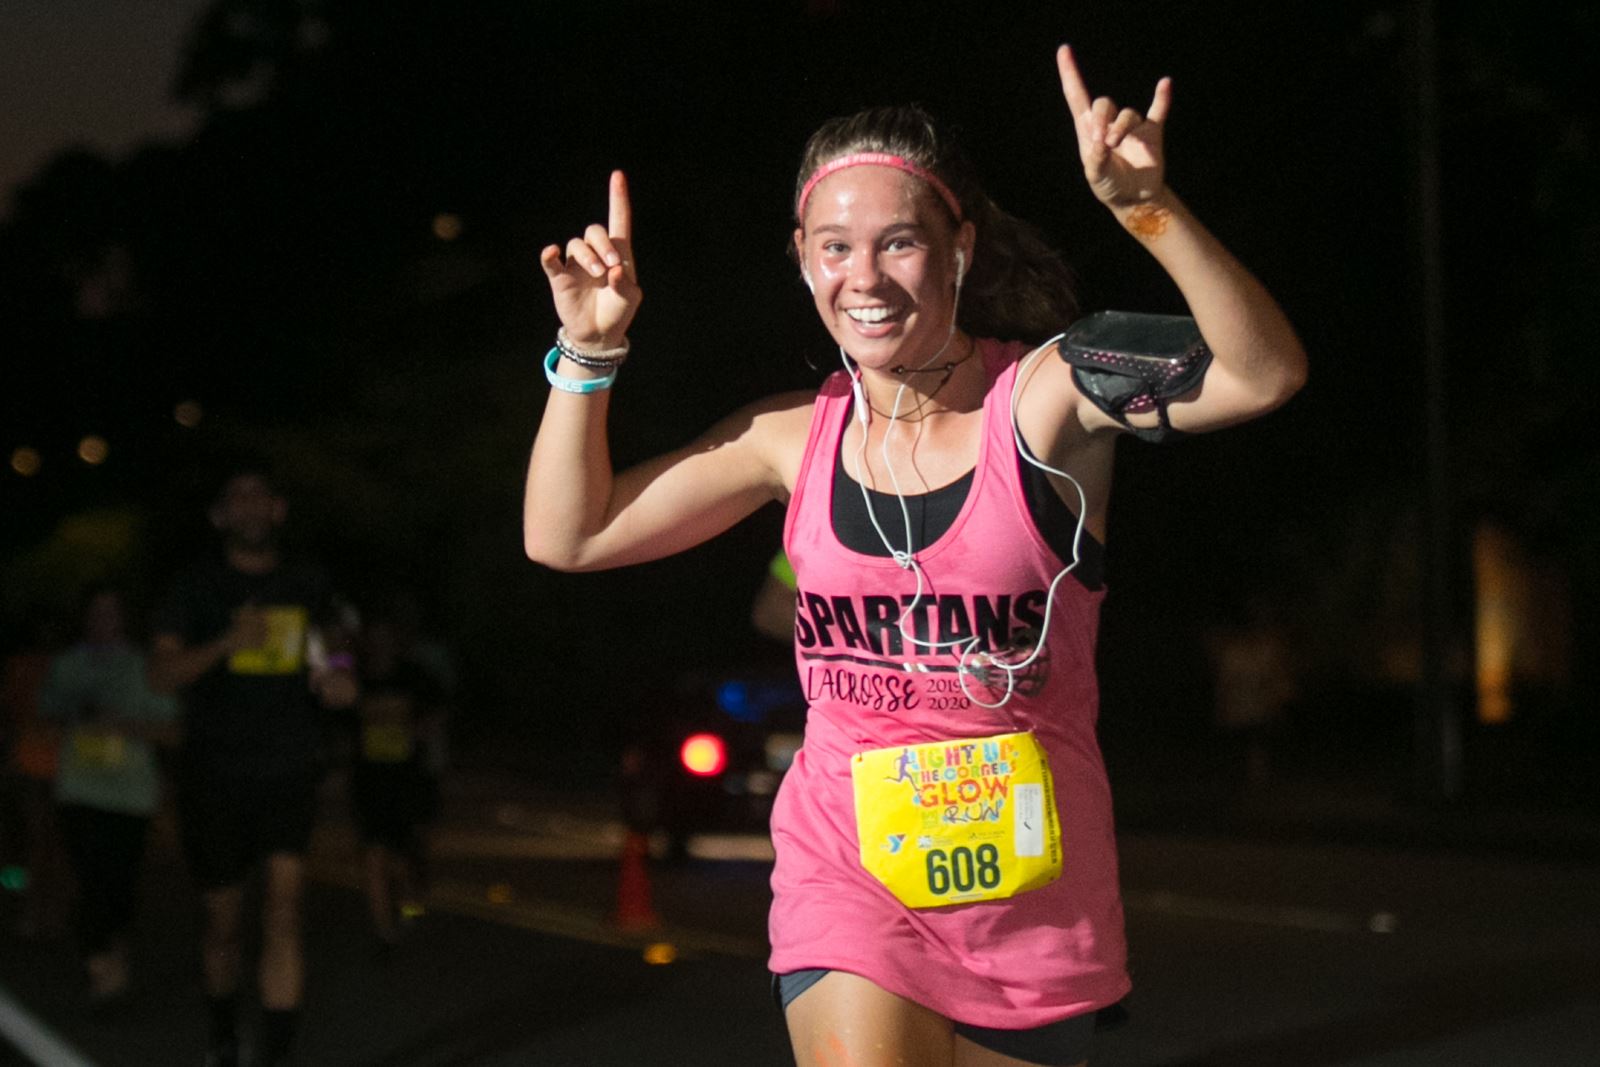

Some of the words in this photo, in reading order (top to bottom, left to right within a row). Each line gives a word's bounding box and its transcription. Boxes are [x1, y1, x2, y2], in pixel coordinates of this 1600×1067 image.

[796, 588, 1048, 657] SPARTANS
[808, 666, 920, 712] LACROSSE
[927, 696, 971, 711] 2020
[911, 769, 940, 786] THE
[943, 760, 1017, 781] CORNERS
[920, 775, 1011, 808] GLOW
[944, 802, 1001, 824] RUN
[926, 843, 1001, 895] 608
